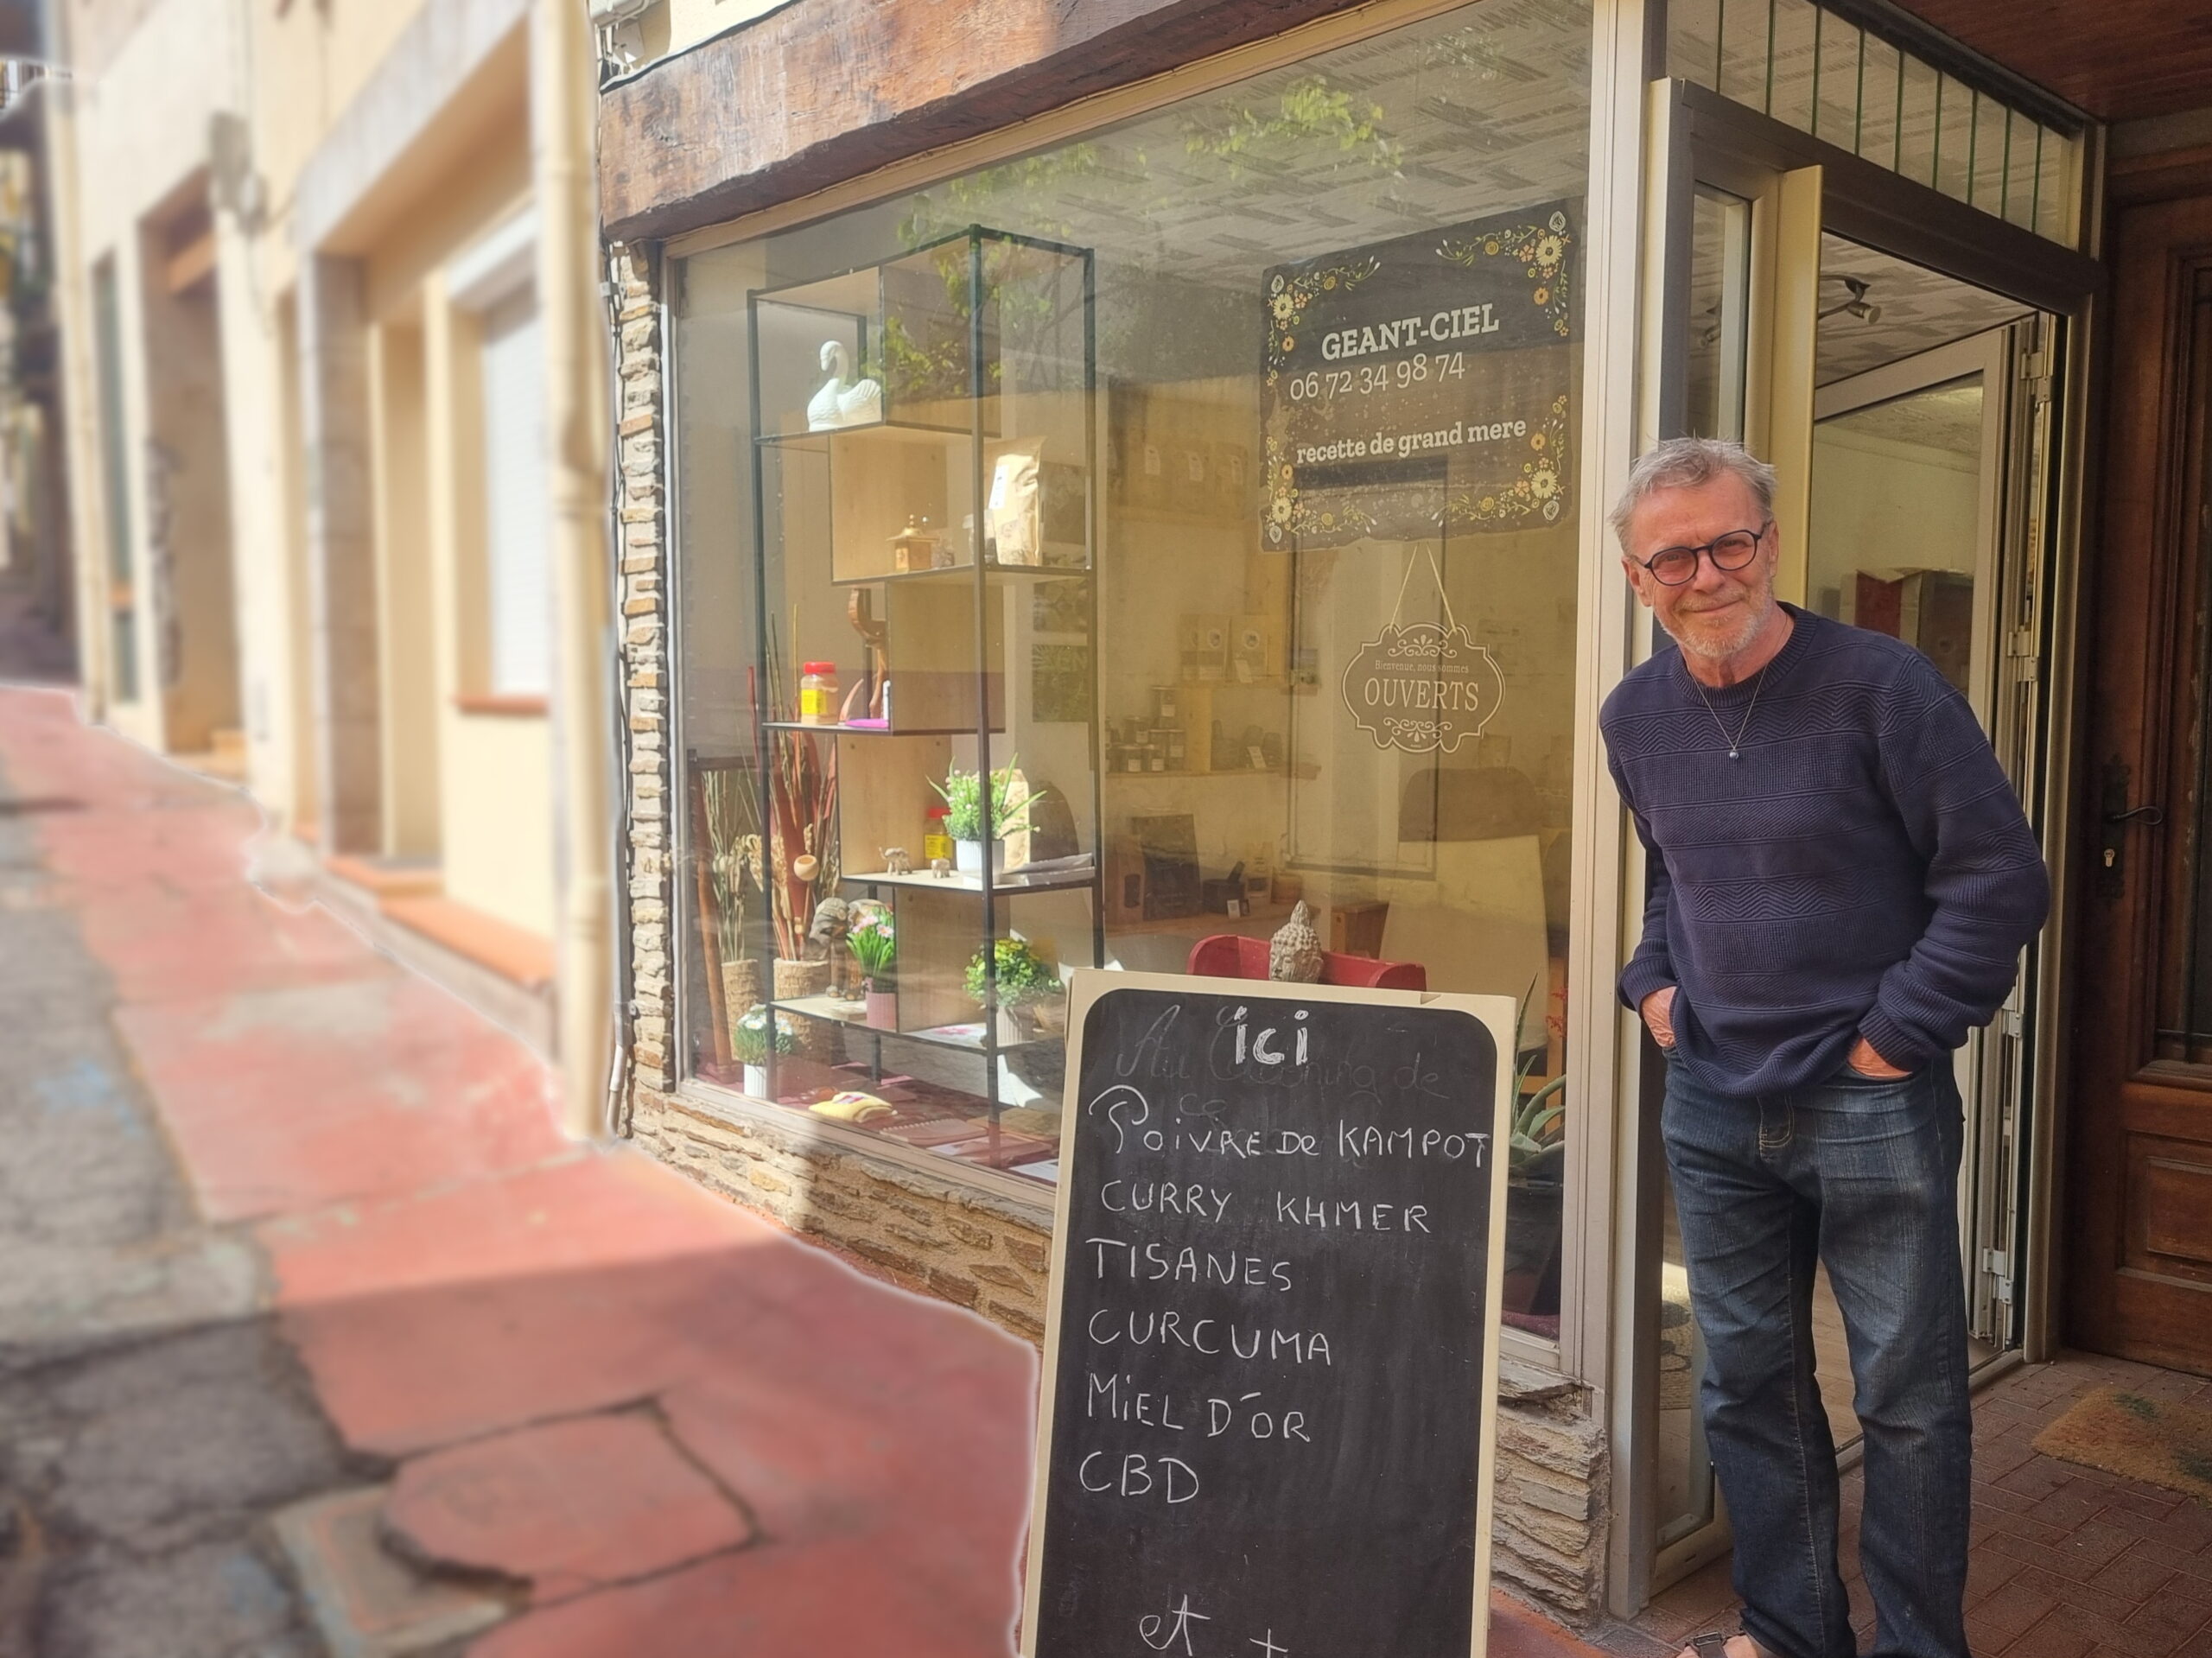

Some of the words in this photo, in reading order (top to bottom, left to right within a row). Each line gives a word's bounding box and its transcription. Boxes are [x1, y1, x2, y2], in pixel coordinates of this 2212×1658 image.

[1321, 302, 1500, 361] GEANT-CIEL
[1290, 372, 1319, 401] 06
[1325, 370, 1353, 400] 72
[1360, 365, 1389, 395] 34
[1396, 353, 1427, 389] 98
[1435, 351, 1465, 383] 74
[1296, 438, 1366, 464] recette
[1370, 431, 1395, 455] de
[1398, 422, 1463, 457] grand
[1467, 419, 1527, 443] mere
[1375, 659, 1416, 672] Bienvenue,
[1417, 664, 1436, 672] nous
[1438, 664, 1469, 674] sommes
[1364, 677, 1479, 711] OUVERTS
[1338, 1119, 1491, 1168] KAMPOT
[1101, 1180, 1232, 1223] CURRY
[1276, 1191, 1431, 1234] KHMER
[1085, 1237, 1292, 1292] TISANES
[1088, 1308, 1332, 1366] CURCUMA
[1079, 1451, 1199, 1504] CBD
[1139, 1594, 1211, 1657] et
